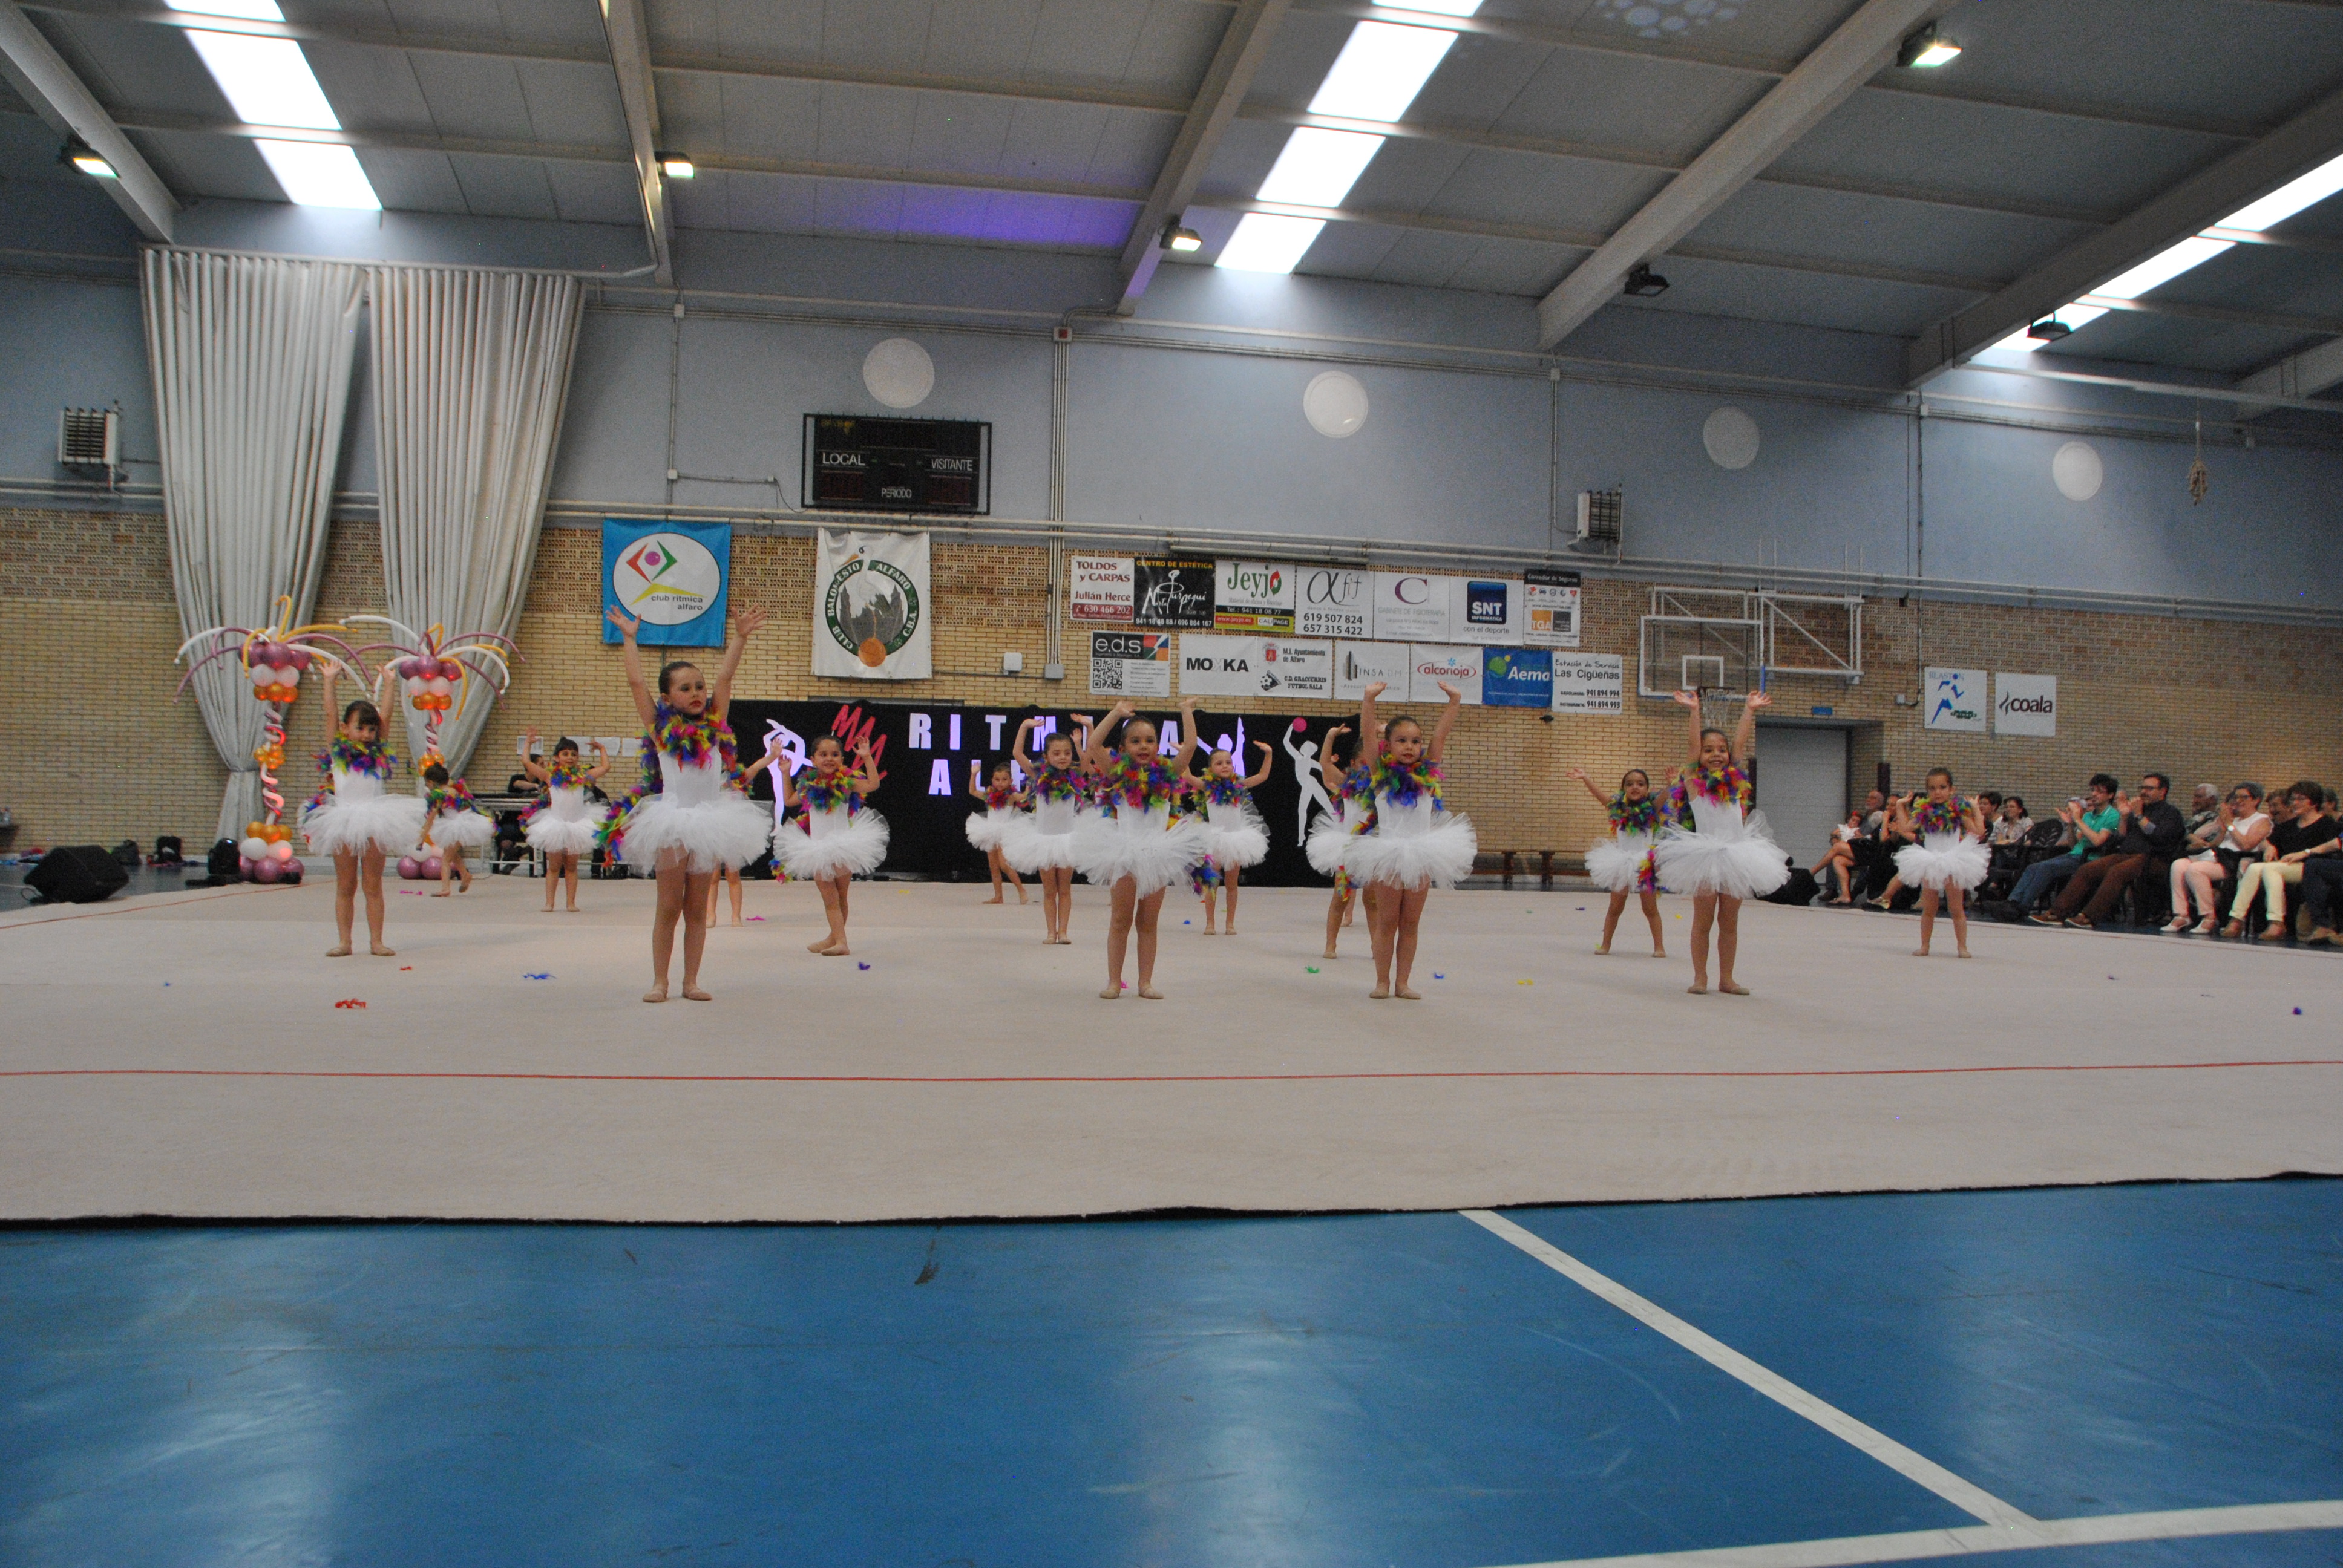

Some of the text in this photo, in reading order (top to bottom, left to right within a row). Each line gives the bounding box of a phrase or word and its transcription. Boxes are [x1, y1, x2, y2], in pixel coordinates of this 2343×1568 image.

[822, 452, 865, 466] LOCAL
[931, 458, 972, 471] VISITANTE
[881, 488, 912, 498] PERIODO
[1076, 561, 1118, 570] TOLDOS
[1079, 573, 1130, 583] y CARPAS
[1227, 562, 1282, 599] Jeyjo
[1075, 590, 1131, 601] Julián Herce
[832, 625, 853, 649] CLUB
[877, 563, 911, 590] ALFARO
[1084, 604, 1098, 613] 630
[1116, 606, 1130, 614] 202
[1472, 601, 1502, 615] SNT
[1303, 612, 1363, 624] 619 507 824
[1303, 624, 1363, 636] 657 315 422
[1531, 619, 1552, 630] TGA
[1095, 636, 1141, 653] e.d.s
[1424, 662, 1469, 679] alcorioja
[1507, 665, 1550, 681] Aema
[1555, 668, 1571, 677] Las
[1610, 701, 1620, 709] 993
[2010, 694, 2053, 713] coala
[908, 713, 1180, 756] RITMIA
